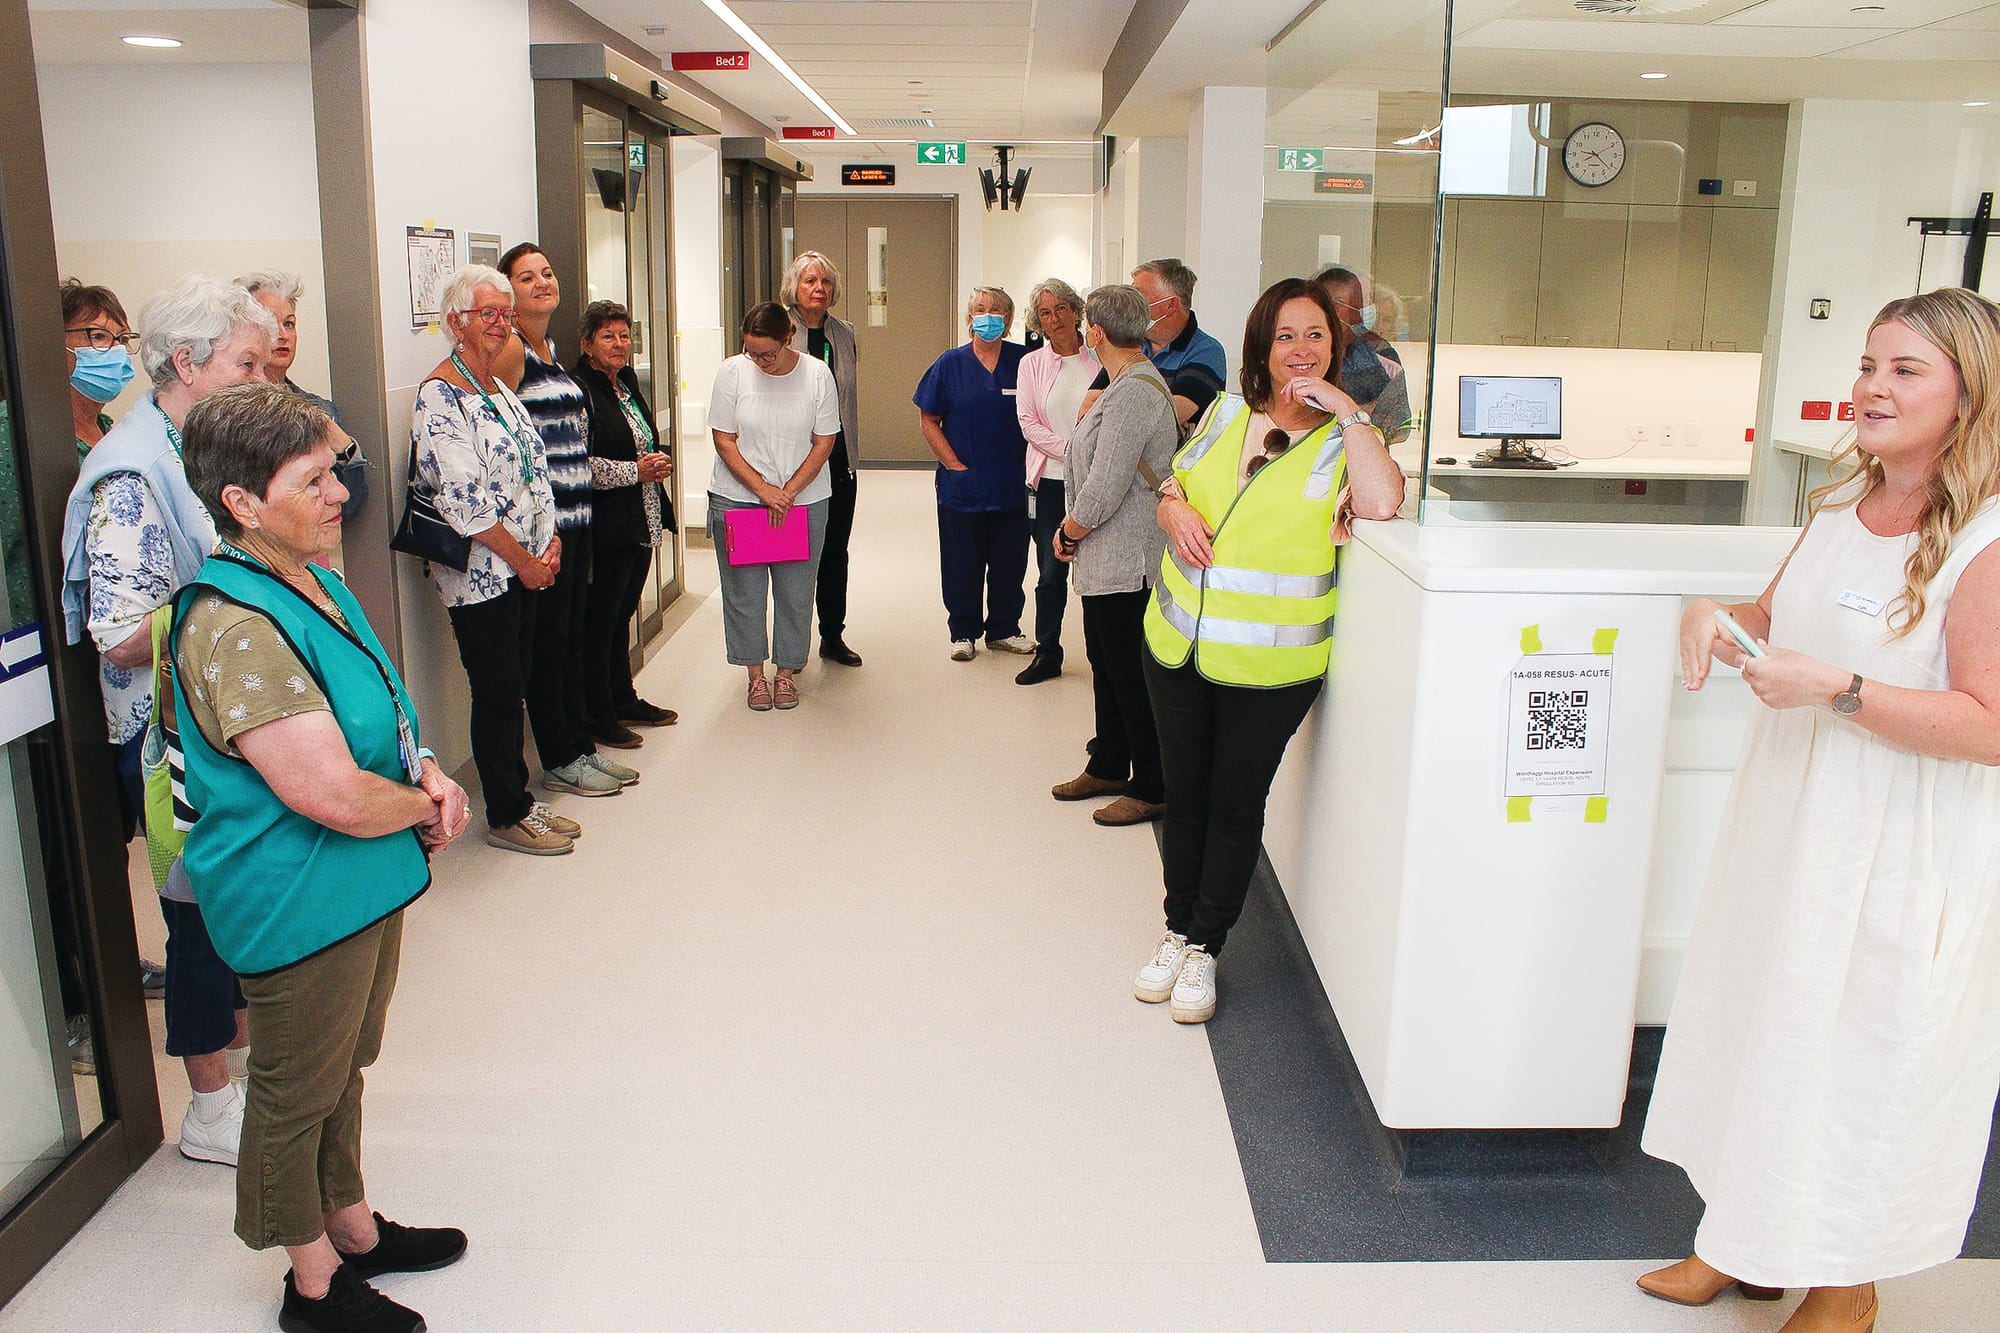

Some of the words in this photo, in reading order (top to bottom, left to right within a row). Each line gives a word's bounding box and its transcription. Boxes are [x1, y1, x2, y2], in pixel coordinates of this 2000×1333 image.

[715, 56, 735, 66] Bed
[737, 56, 744, 66] 2
[812, 129, 826, 137] Bed
[826, 129, 831, 137] 1
[157, 407, 183, 450] VOLUNTEE
[1513, 671, 1542, 679] 1A-058
[1580, 669, 1611, 677] ACUTE
